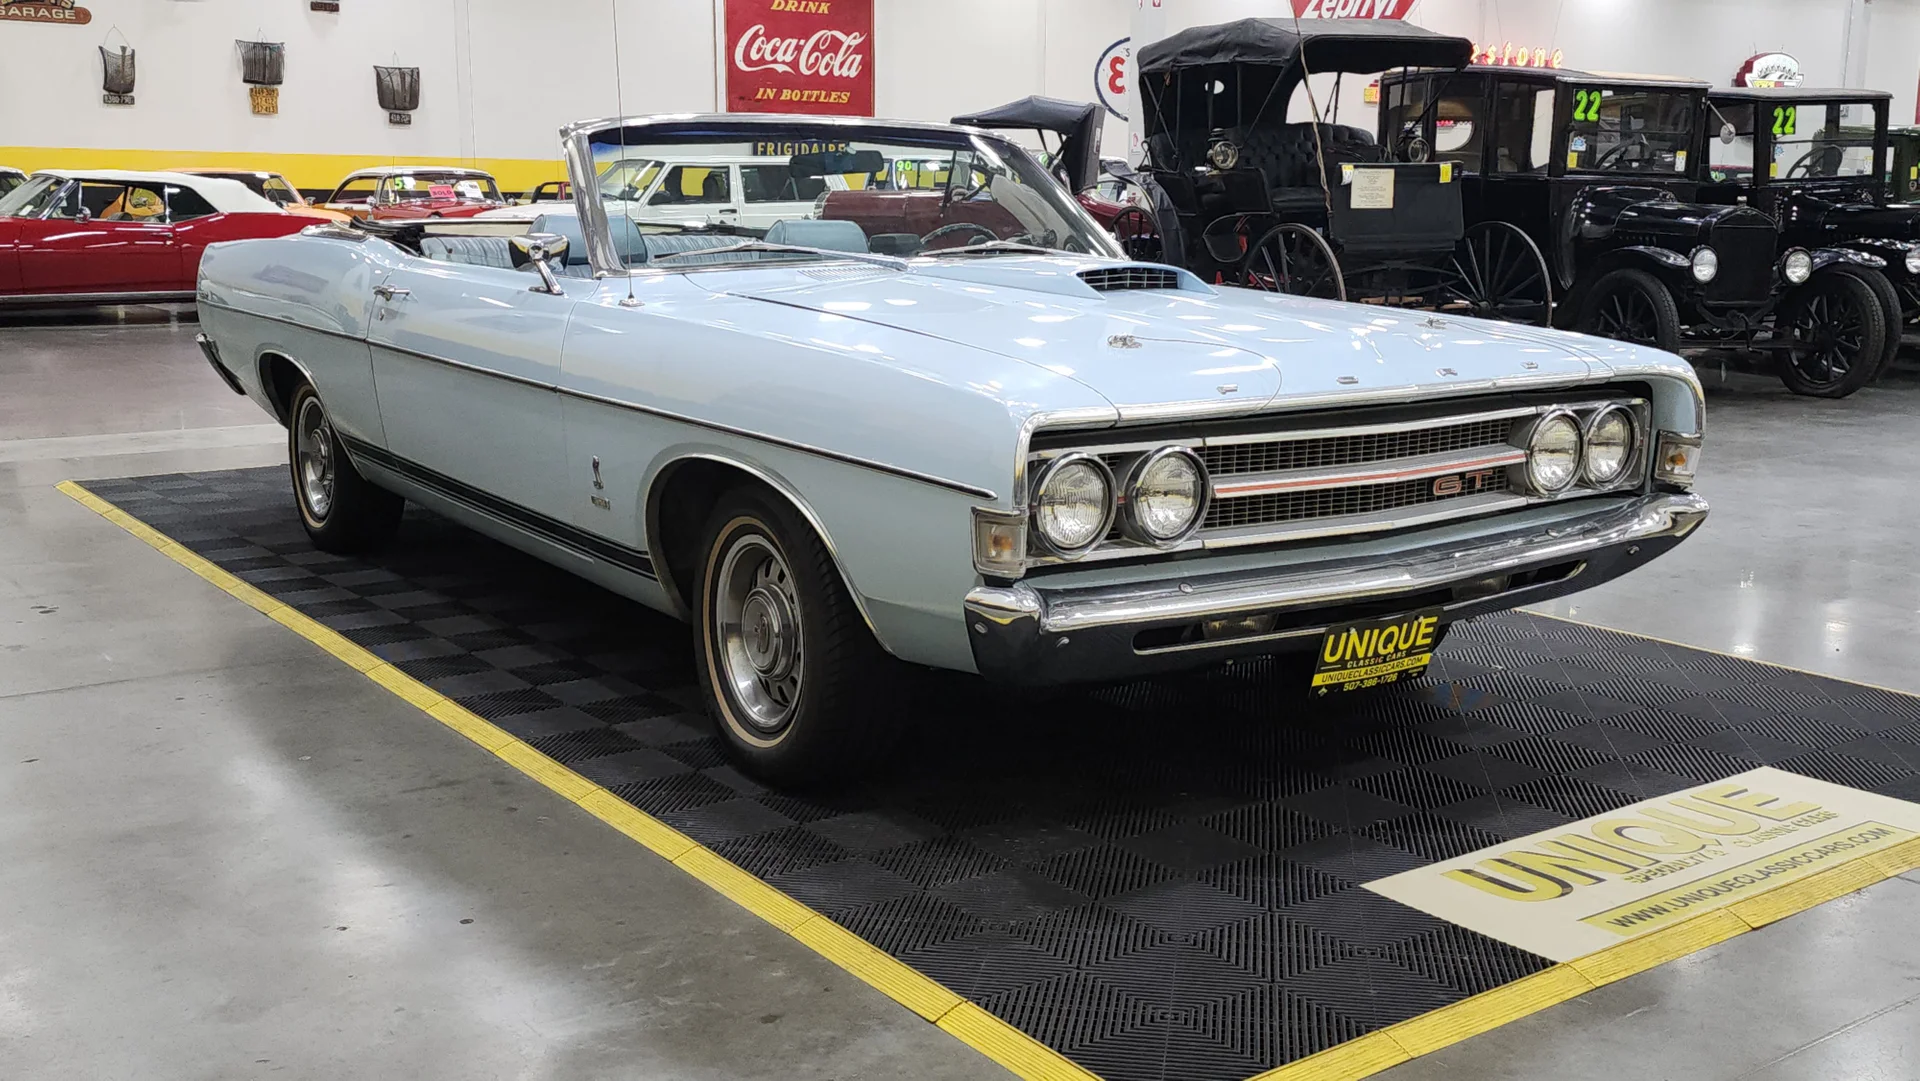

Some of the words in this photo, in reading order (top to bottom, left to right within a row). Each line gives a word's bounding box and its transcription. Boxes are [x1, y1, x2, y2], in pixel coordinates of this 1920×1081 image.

[770, 0, 831, 14] DRINK
[734, 24, 868, 78] Coca-Cola
[755, 87, 777, 100] IN
[779, 89, 851, 104] BOTTLES
[1574, 89, 1602, 122] 22
[1772, 106, 1796, 135] 22
[1433, 469, 1493, 496] GT
[1323, 616, 1438, 663] UNIQUE
[1321, 656, 1424, 683] UNIQUECLASSICCARS.COM
[1347, 657, 1384, 669] CLASSIC
[1386, 650, 1407, 661] CARS
[1440, 784, 1822, 902] UNIQUE
[1606, 827, 1896, 929] WWW.UNIQUECLASSICCARS.COM
